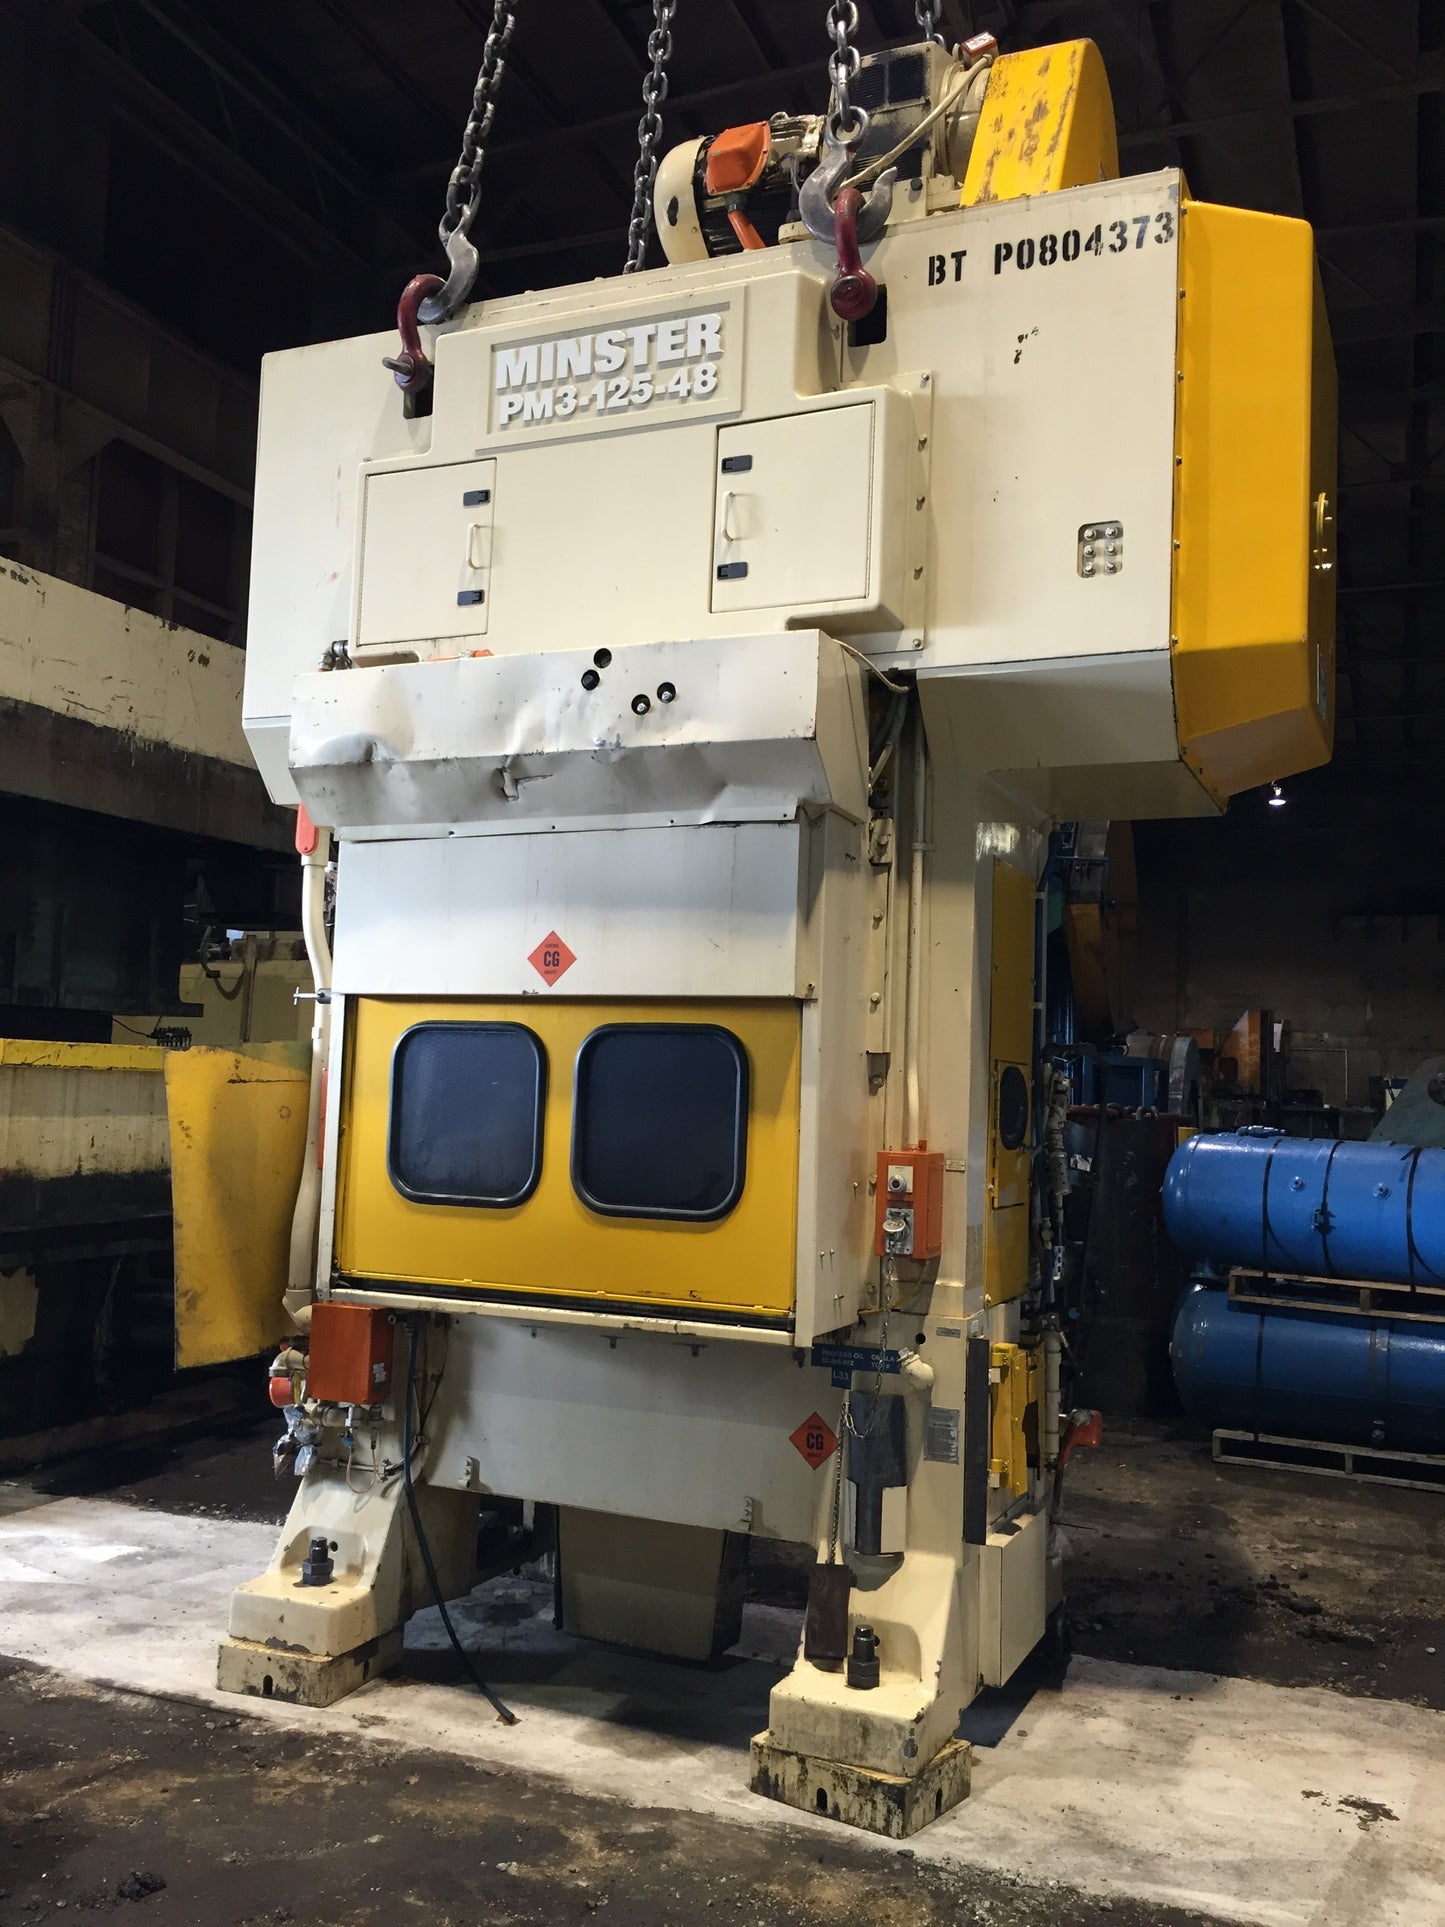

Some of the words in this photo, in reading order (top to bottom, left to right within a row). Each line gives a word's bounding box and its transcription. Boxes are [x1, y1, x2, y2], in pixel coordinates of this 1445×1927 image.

[928, 250, 967, 287] BT
[994, 211, 1175, 276] P0804373
[496, 313, 724, 390] MINSTER
[499, 361, 719, 426] PM3-125-48
[544, 951, 560, 967] CG
[806, 1432, 824, 1450] CG
